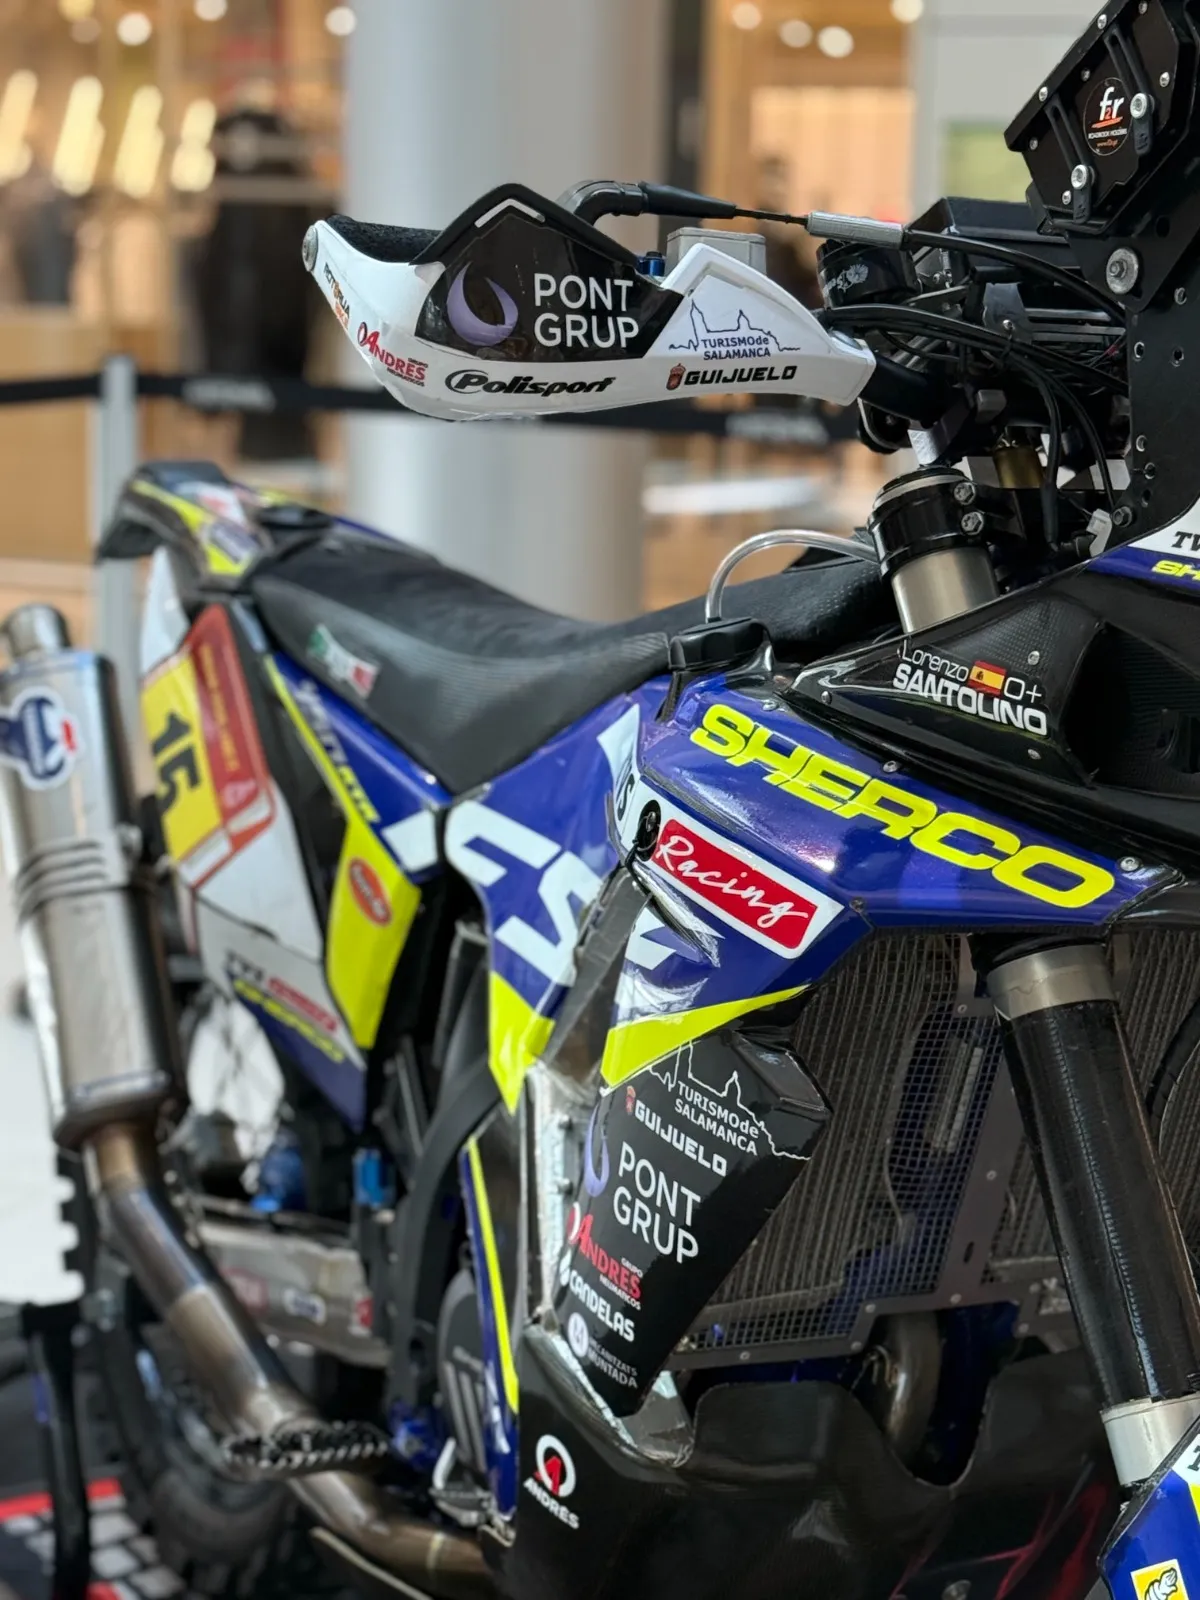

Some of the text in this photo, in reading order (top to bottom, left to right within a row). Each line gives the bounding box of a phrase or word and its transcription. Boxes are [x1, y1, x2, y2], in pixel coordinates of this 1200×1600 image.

[534, 273, 634, 312] PONT
[534, 313, 639, 349] GRUP
[700, 337, 770, 349] TURISMOde
[703, 349, 771, 361] SALAMANCA
[445, 369, 617, 397] Polisport
[684, 366, 798, 386] GUIJUELO
[901, 638, 969, 683] Lorenzo
[893, 664, 1048, 736] SANTOLINO
[152, 711, 201, 812] 15
[690, 703, 1116, 909] SHERCO
[656, 835, 808, 928] Racing
[675, 1098, 758, 1156] SALAMANCA
[677, 1080, 759, 1139] TURISMOde
[635, 1101, 728, 1177] GUIJUELO
[618, 1141, 702, 1227] PONT
[613, 1186, 699, 1264] GRUP
[569, 1270, 635, 1343] CANDELAS
[523, 1476, 580, 1530] ANDRES
